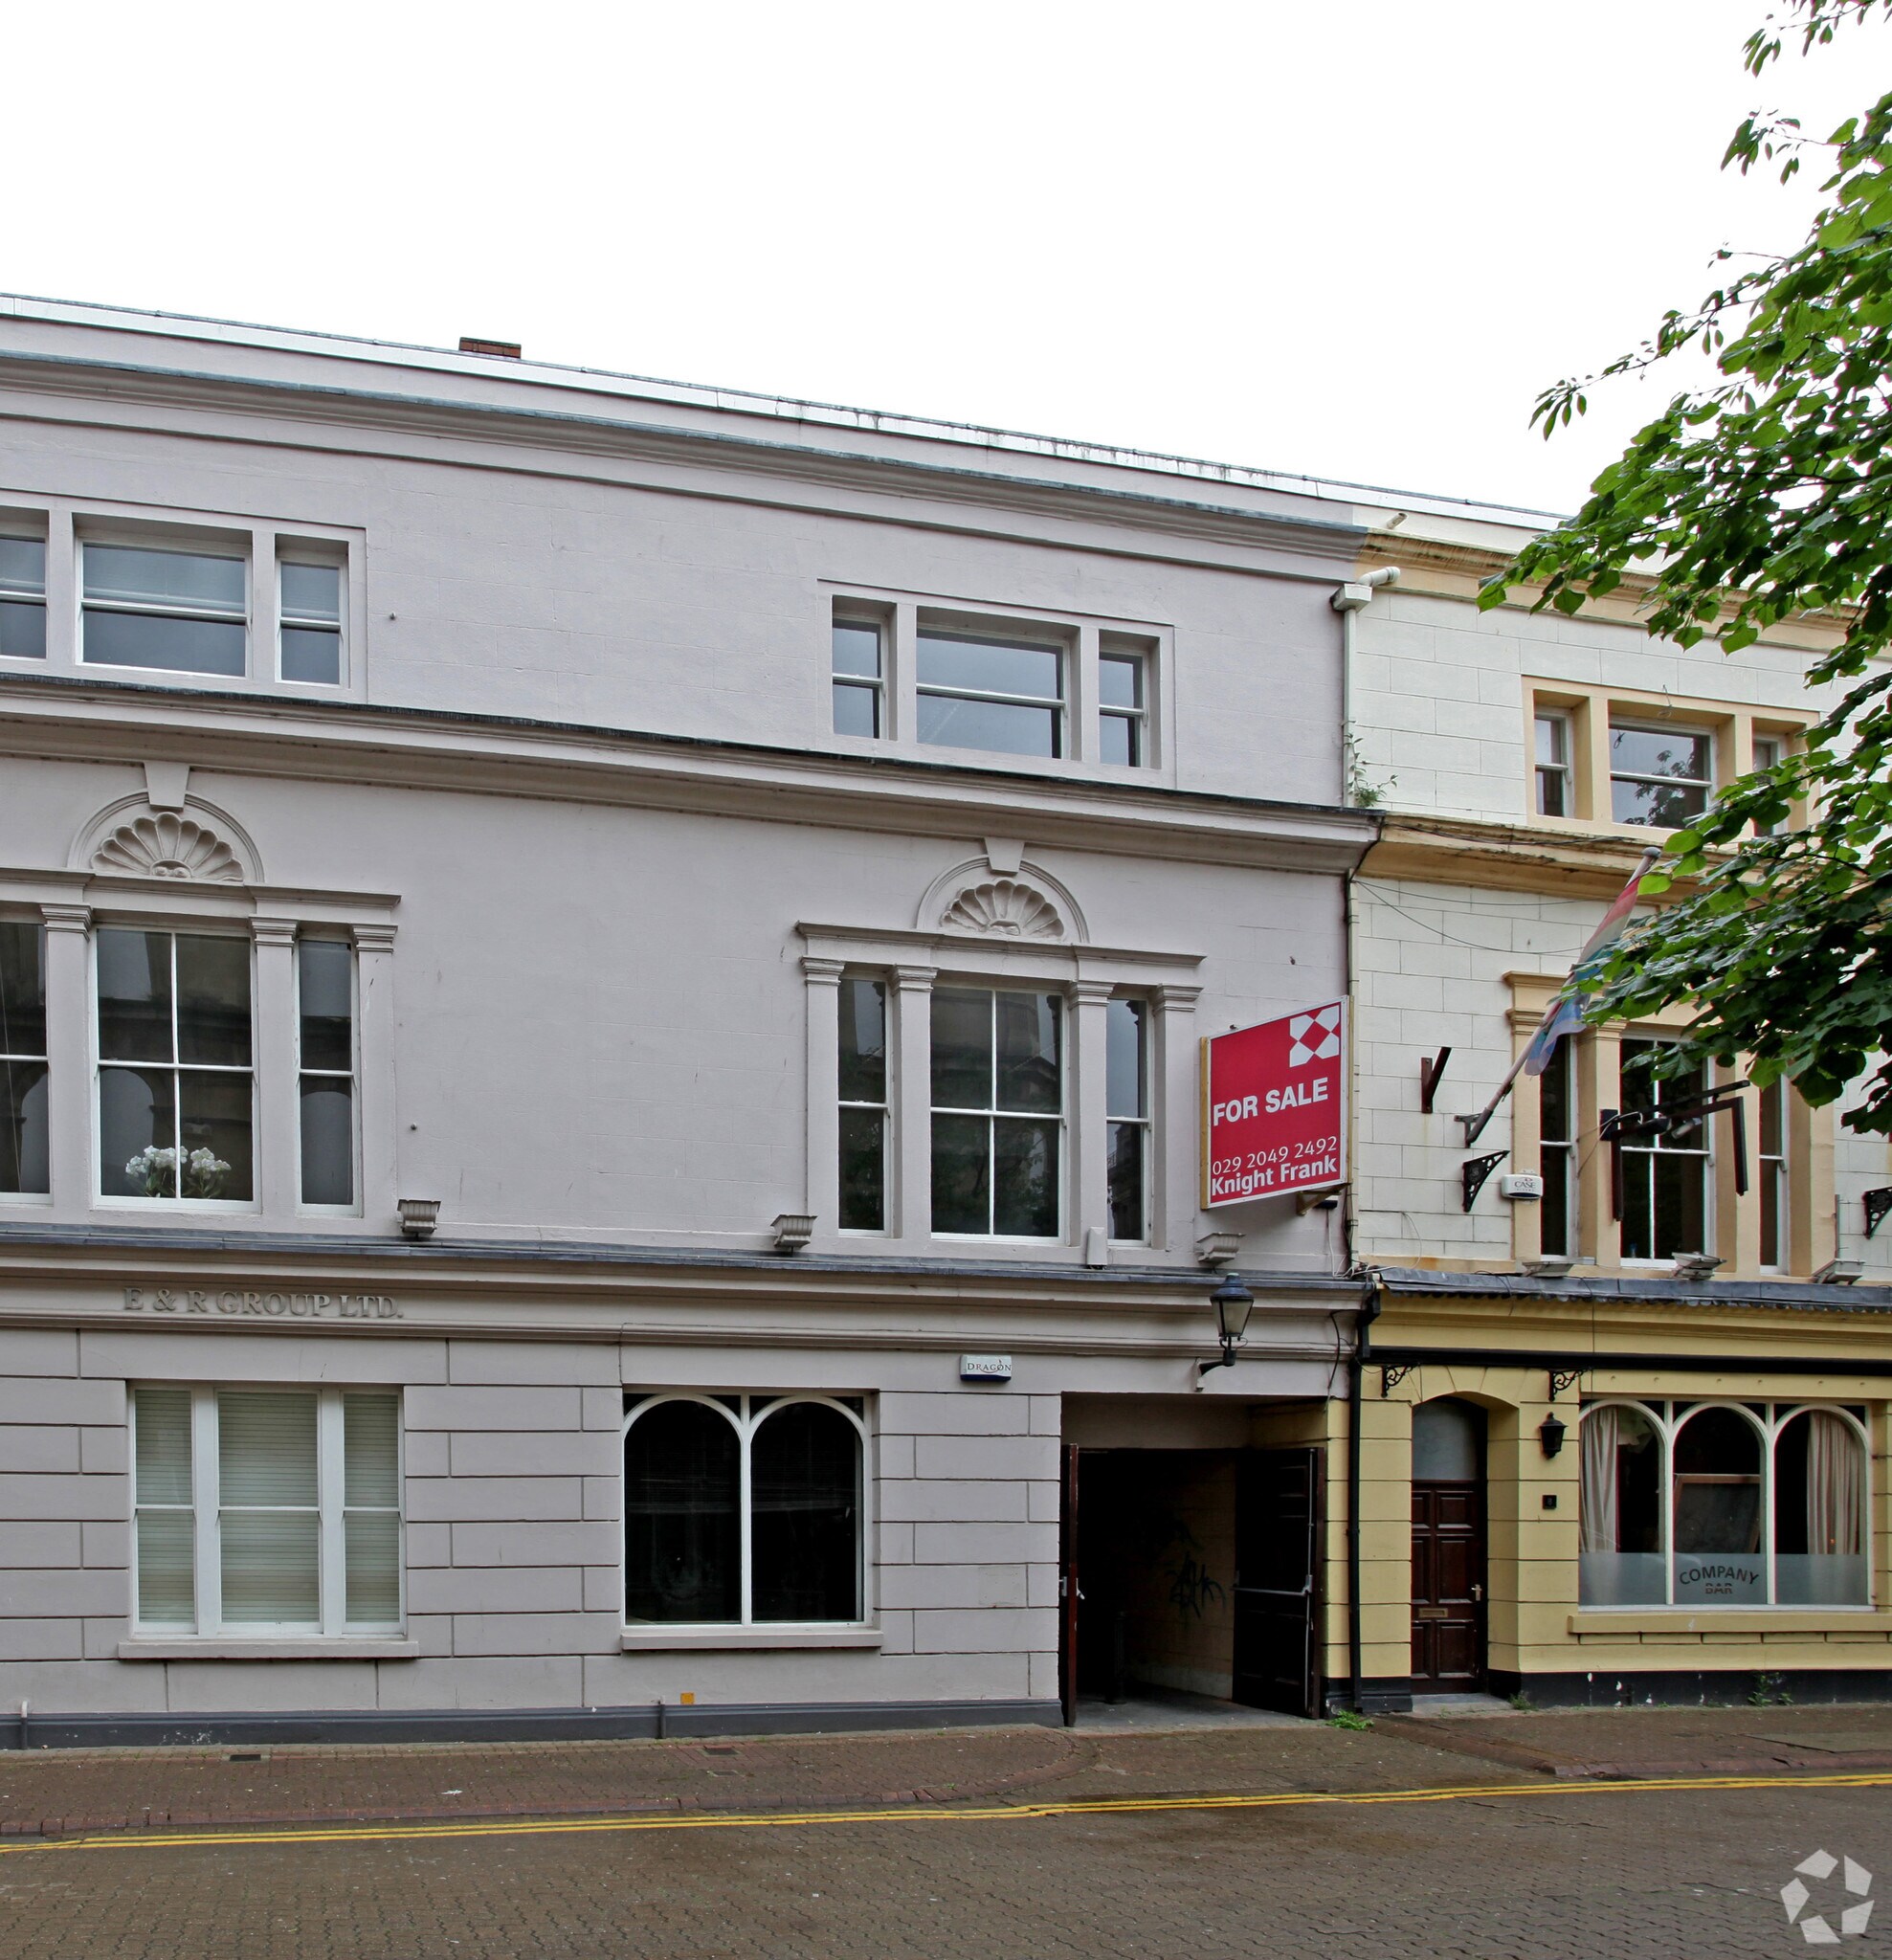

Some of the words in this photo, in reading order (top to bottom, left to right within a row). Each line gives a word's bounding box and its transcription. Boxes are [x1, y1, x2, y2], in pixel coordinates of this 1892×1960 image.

[1213, 1095, 1258, 1126] FOR
[1265, 1077, 1328, 1113] SALE
[1213, 1156, 1241, 1175] 029
[1247, 1146, 1289, 1169] 2049
[1294, 1135, 1337, 1159] 2492
[1212, 1167, 1274, 1195] Knight
[1280, 1154, 1337, 1183] Frank
[122, 1287, 144, 1311] E
[152, 1288, 176, 1312] &
[186, 1290, 208, 1313] R
[215, 1290, 330, 1317] GROUP
[339, 1294, 404, 1319] LTD.
[967, 1362, 1012, 1372] DRAGON
[1679, 1566, 1760, 1585] COMPANY
[1705, 1582, 1733, 1594] BAR
